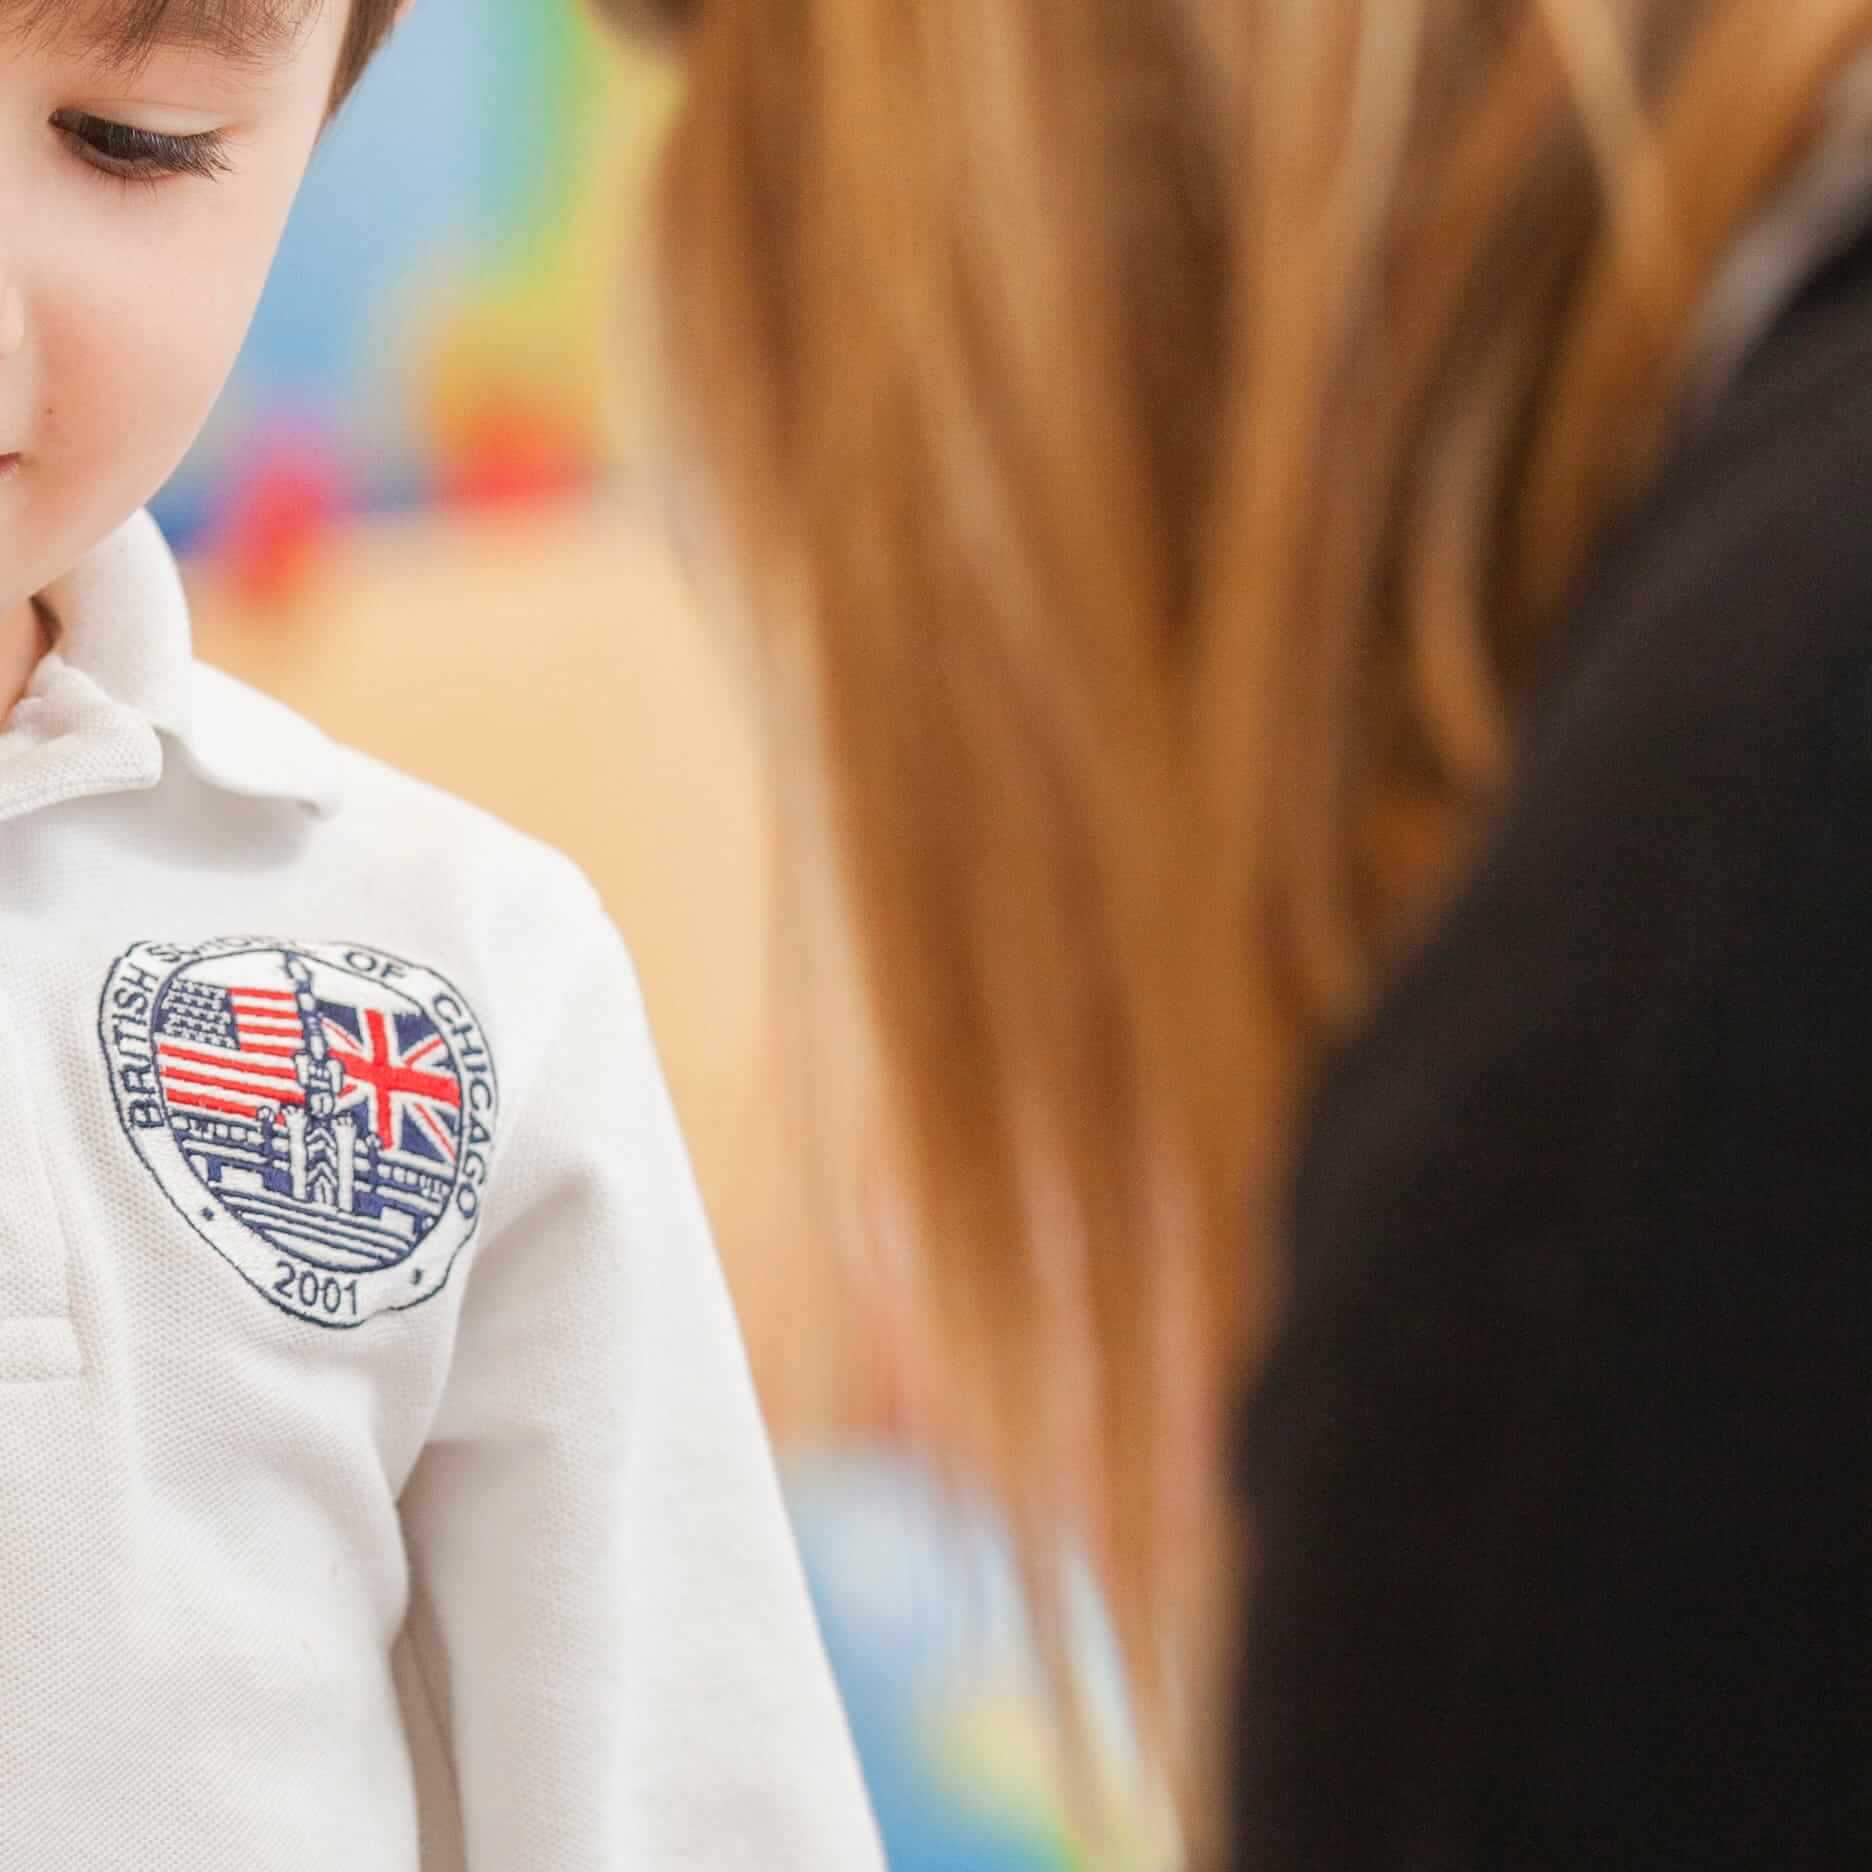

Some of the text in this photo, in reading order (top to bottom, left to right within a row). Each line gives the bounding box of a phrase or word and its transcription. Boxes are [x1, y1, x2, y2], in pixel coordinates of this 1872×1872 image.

[111, 963, 165, 1128] BRITISH
[344, 950, 407, 979] OF
[432, 992, 492, 1220] CHICAGO
[273, 1260, 358, 1316] 2001
